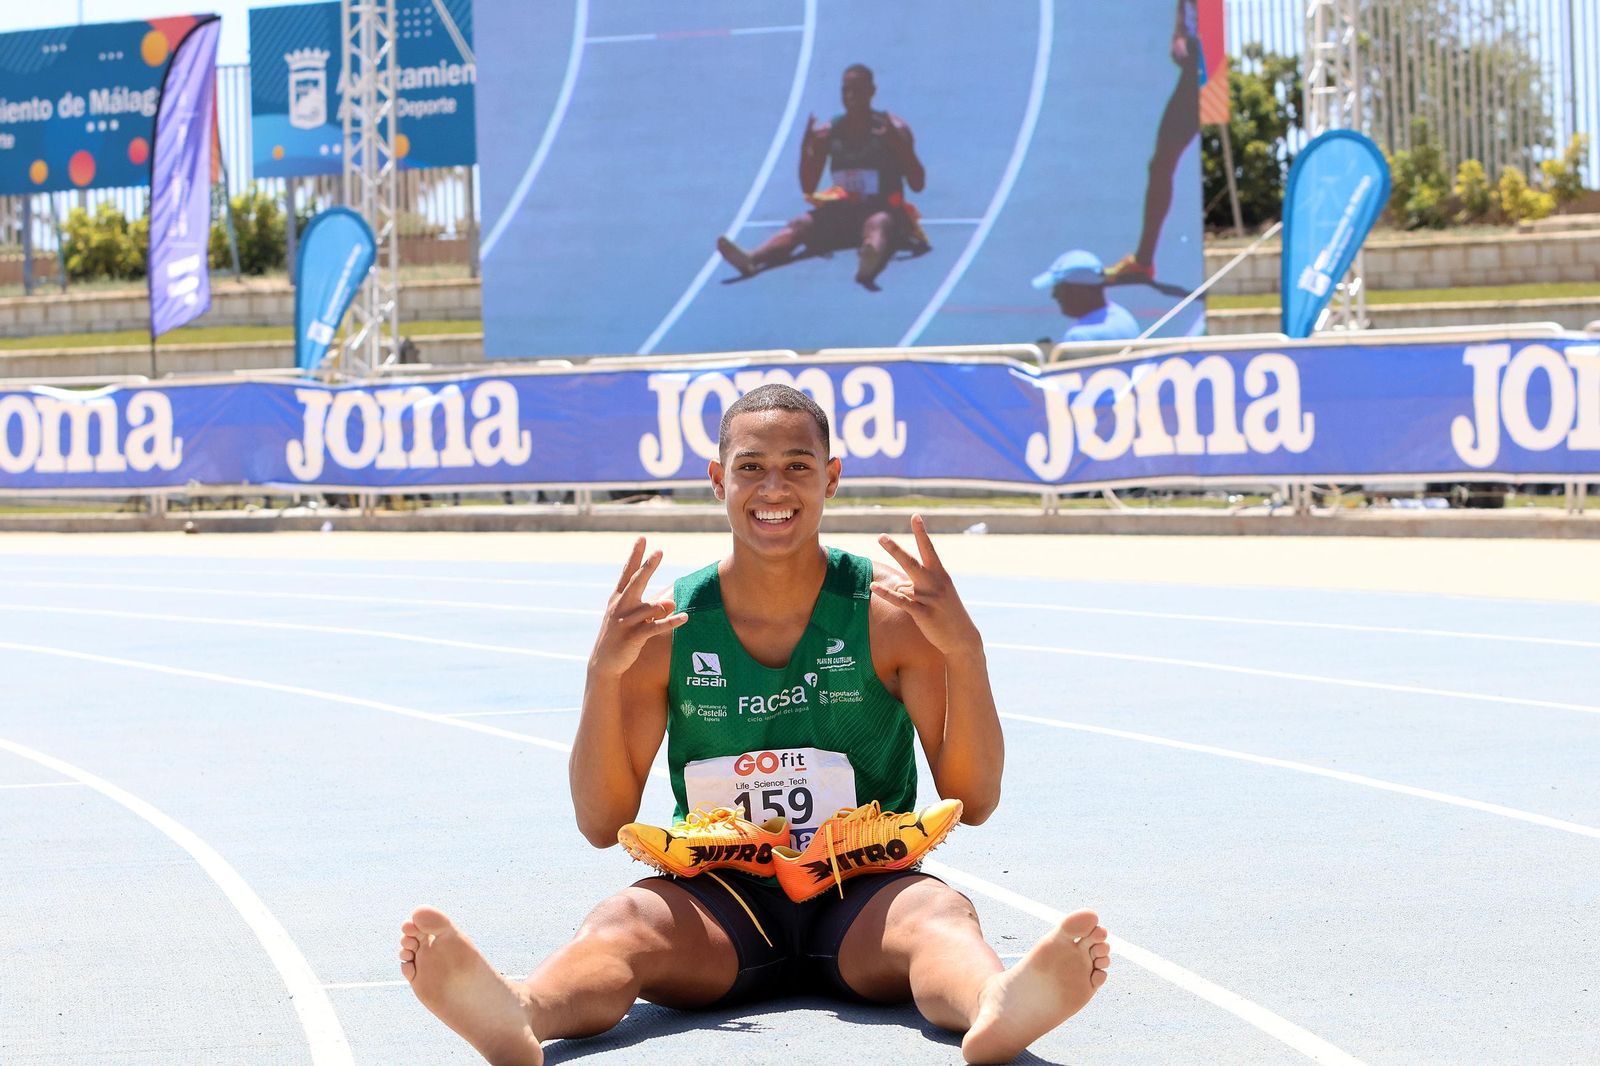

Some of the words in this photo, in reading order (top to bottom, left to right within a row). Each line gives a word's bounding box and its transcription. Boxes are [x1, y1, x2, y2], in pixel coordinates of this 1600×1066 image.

[57, 92, 86, 119] de
[1025, 352, 1314, 481] Joma
[286, 380, 532, 481] Joma
[686, 676, 727, 687] rasán
[829, 689, 860, 698] Diputació
[697, 708, 728, 717] Castelló
[738, 686, 808, 714] Facsa
[734, 787, 813, 825] 159
[686, 842, 773, 868] NITRO
[800, 839, 908, 884] NITRO
